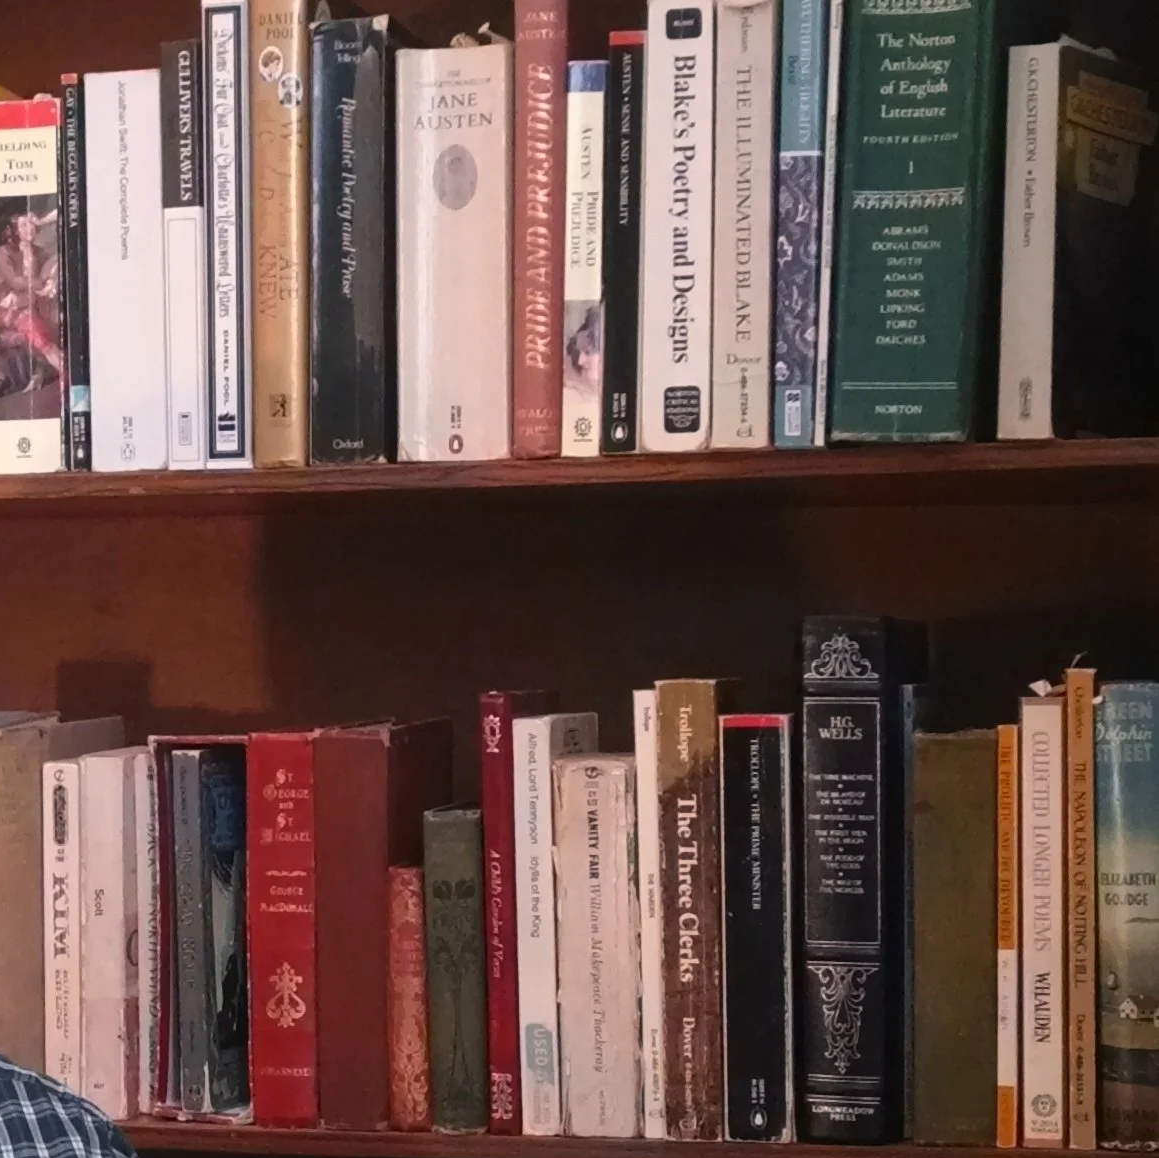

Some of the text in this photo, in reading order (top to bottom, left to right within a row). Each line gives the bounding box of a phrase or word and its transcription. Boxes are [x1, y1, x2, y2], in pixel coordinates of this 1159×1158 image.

[878, 32, 956, 48] The Norton
[622, 53, 632, 94] AUSTEN
[880, 57, 950, 74] Anthology
[880, 80, 948, 96] of English
[430, 92, 478, 112] JANE
[673, 54, 696, 139] Blake's
[880, 104, 946, 119] Literature
[177, 51, 194, 201] GULLIVER'S TRAVELS
[414, 113, 493, 130] AUSTEN
[6, 159, 34, 170] TOM
[117, 81, 131, 261] Jonathan The Complete Poems
[580, 126, 594, 179] AUSTEN
[2, 171, 39, 184] JONES
[335, 98, 358, 300] Romantic Poetry and Prose
[668, 144, 694, 220] Poetry
[526, 64, 553, 369] PRIDE AND PREJUDICE
[735, 65, 752, 344] THE ILLUMINATED BLAKE
[570, 190, 584, 270] PREJUDICE
[586, 191, 599, 268] PRIDE AND
[673, 226, 693, 266] and
[258, 245, 277, 319] KNEW
[279, 256, 299, 302] ATE
[883, 272, 924, 282] ADAMS
[886, 256, 922, 266] SMITH
[886, 288, 921, 298] MONK
[668, 275, 694, 364] Designs
[876, 334, 926, 346] DAICHES
[886, 319, 918, 330] FORD
[874, 404, 922, 415] NORTON
[678, 703, 694, 762] Trollope
[818, 728, 863, 740] WELLS
[677, 794, 698, 838] The
[750, 738, 762, 910] TROLLOPE THE MINISTER
[526, 769, 542, 938] Lord Tennyson King
[1032, 732, 1052, 952] COLLECTED LONGER POEMS
[587, 810, 601, 935] VANITY FAIR William
[678, 841, 698, 908] Three
[1074, 762, 1088, 989] THE NAPOLEON OF NOTTING HILL
[1100, 872, 1156, 886] ELIZABETH
[53, 872, 70, 959] KIM
[94, 888, 104, 917] Scott
[680, 912, 700, 983] Clerks
[532, 1026, 546, 1066] USED
[680, 1016, 696, 1059] Dover
